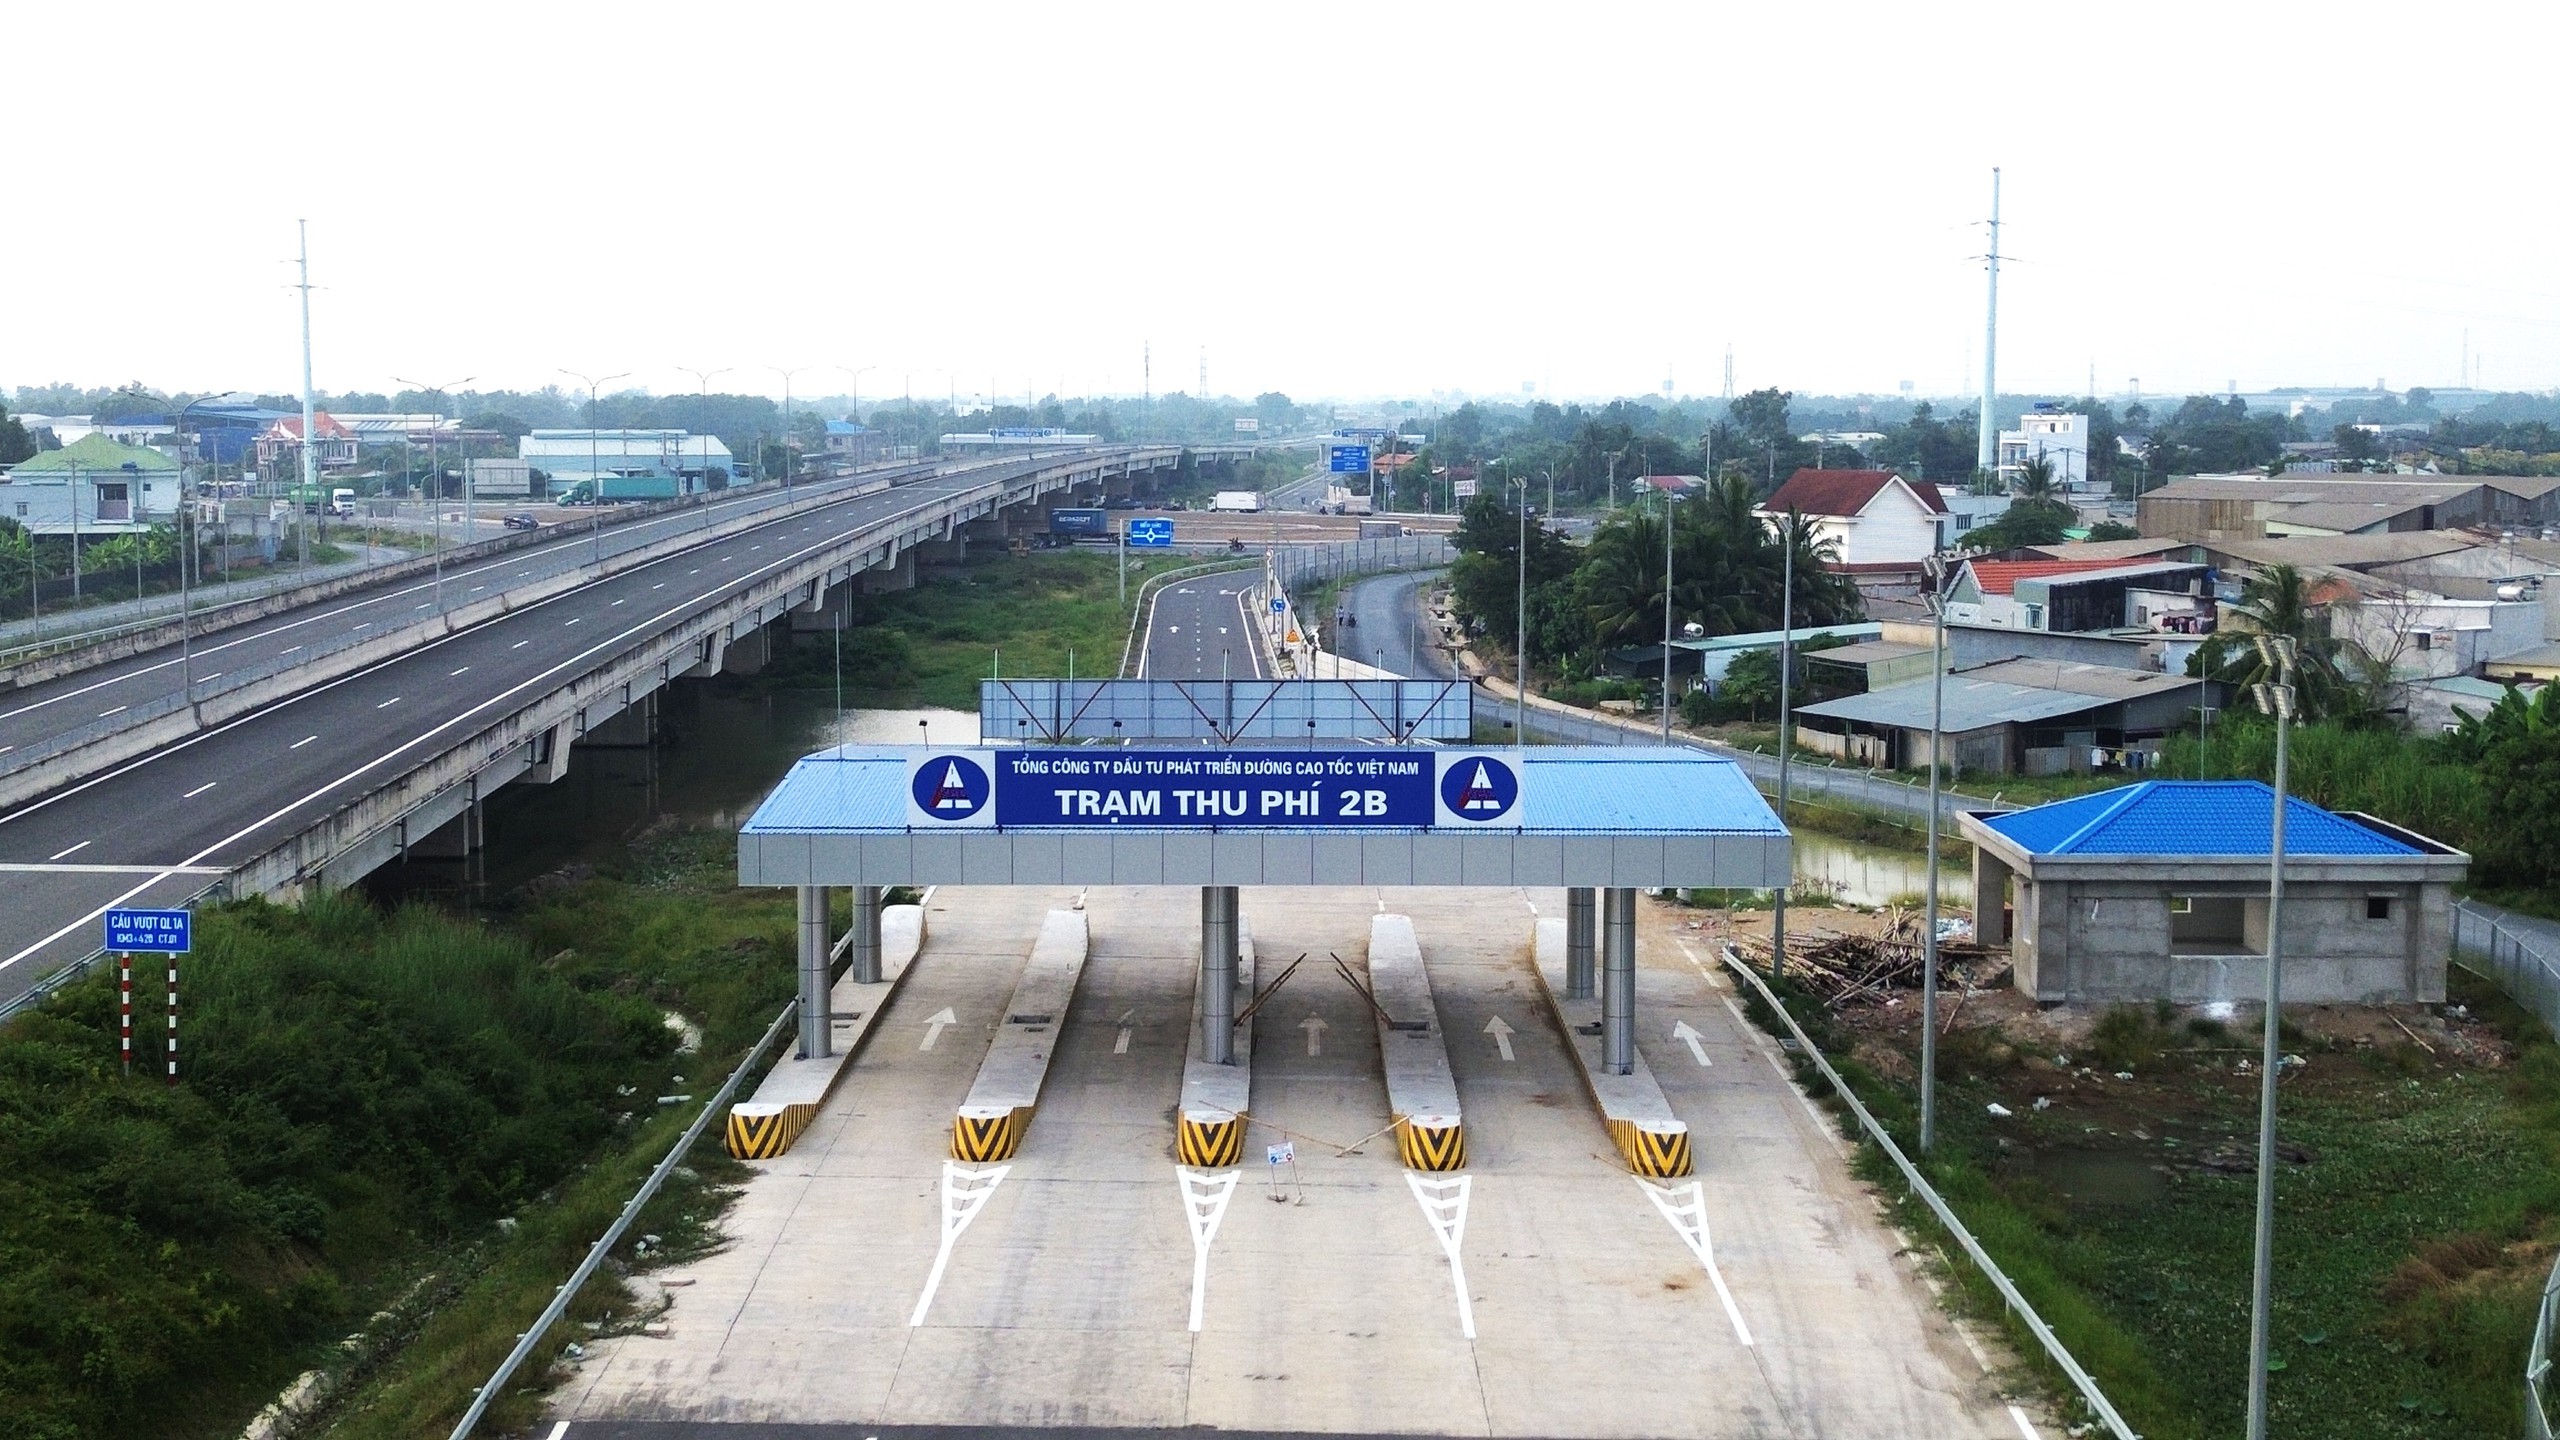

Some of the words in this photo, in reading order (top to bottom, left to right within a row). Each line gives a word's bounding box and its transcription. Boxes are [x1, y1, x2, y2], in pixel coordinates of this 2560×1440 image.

[1012, 753, 1049, 774] TỔNG
[1052, 757, 1090, 774] CÔNG
[1093, 761, 1110, 774] TY
[1113, 756, 1142, 774] ĐẦU
[1145, 760, 1163, 774] TƯ
[1167, 758, 1201, 774] PHÁT
[1204, 754, 1242, 775] TRIỂN
[1244, 758, 1292, 775] ĐƯỜNG
[1295, 761, 1324, 775] CAO
[1327, 756, 1354, 775] TỐC
[1357, 758, 1385, 778] VIỆT
[1388, 762, 1419, 775] NAM
[1054, 789, 1161, 823] TRẠM
[1173, 789, 1247, 816] THU
[1261, 780, 1322, 816] PHÍ
[1339, 790, 1388, 816] 2B
[111, 913, 131, 929] CẦU
[133, 916, 158, 930] VƯỢT
